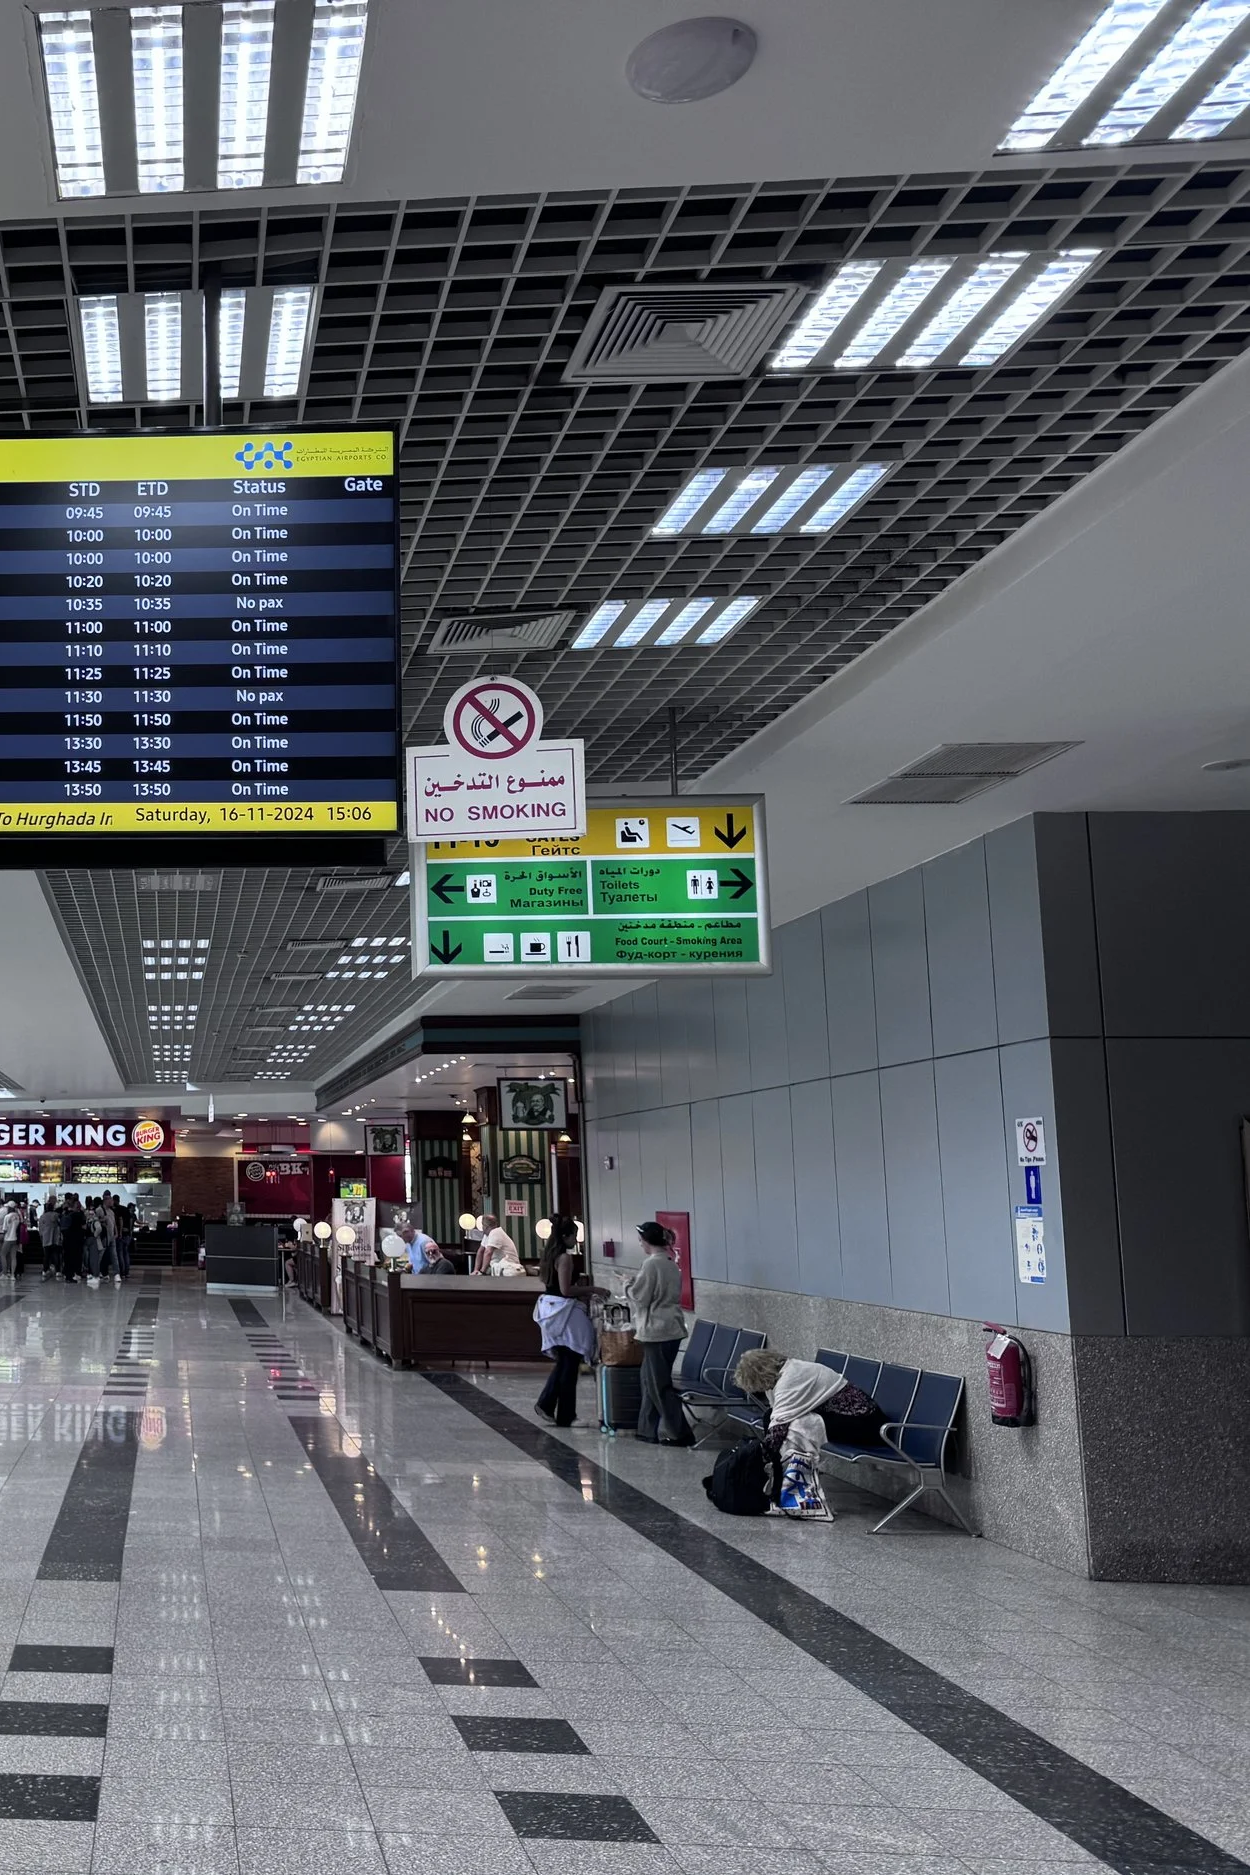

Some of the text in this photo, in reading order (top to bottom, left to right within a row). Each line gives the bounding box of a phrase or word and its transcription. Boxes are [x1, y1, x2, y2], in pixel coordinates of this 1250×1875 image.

[70, 483, 100, 496] STD
[138, 482, 168, 495] ETD
[234, 480, 285, 494] Status
[345, 477, 382, 491] Gate
[66, 507, 103, 519] 09:45
[134, 506, 171, 518] 09:45
[232, 504, 287, 516] On Time
[67, 530, 103, 542] 10:00
[135, 529, 171, 541] 10:00
[232, 527, 287, 539] On Time
[67, 553, 103, 565] 10:00
[135, 552, 171, 564] 10:00
[66, 576, 103, 588] 10:20
[134, 575, 171, 587] 10:20
[232, 573, 287, 585] On Time
[66, 599, 102, 610] 10:35
[134, 598, 170, 610] 10:35
[237, 597, 283, 611] No pax
[66, 622, 102, 633] 11:00
[134, 621, 171, 633] 11:00
[66, 645, 102, 657] 11:10
[134, 644, 171, 656] 11:10
[232, 643, 288, 655] On Time
[66, 668, 102, 680] 11:25
[134, 667, 170, 679] 11:25
[232, 666, 288, 678] On Time
[65, 691, 102, 703] 11:30
[134, 690, 171, 702] 11:30
[237, 690, 283, 704] No pax
[65, 714, 102, 726] 11:50
[134, 714, 171, 726] 11:50
[65, 737, 102, 749] 13:30
[134, 737, 170, 749] 13:30
[232, 736, 288, 748] On Time
[65, 761, 101, 773] 13:45
[133, 760, 170, 772] 13:45
[133, 784, 170, 795] 13:50
[232, 783, 288, 795] On Time
[425, 770, 564, 797] ممنوع التدخين
[65, 784, 101, 796] 13:50
[136, 807, 314, 824] Saturday, 16-11-2024
[328, 807, 371, 820] 15:06
[425, 802, 566, 822] NO SMOKING
[16, 812, 95, 829] Hurghada
[532, 845, 580, 855] Гейтс
[536, 868, 582, 881] الأسواق
[600, 868, 660, 878] دورات المياه
[600, 881, 639, 889] Toilets
[530, 888, 554, 897] Duty
[600, 892, 657, 905] Туалеты
[510, 899, 583, 908] Магазины
[641, 937, 667, 945] Court
[676, 937, 717, 946] Smoking
[616, 950, 742, 960] Фуд-корт курения
[56, 1125, 125, 1146] KING
[134, 1127, 160, 1138] BURGER
[136, 1132, 161, 1143] KING
